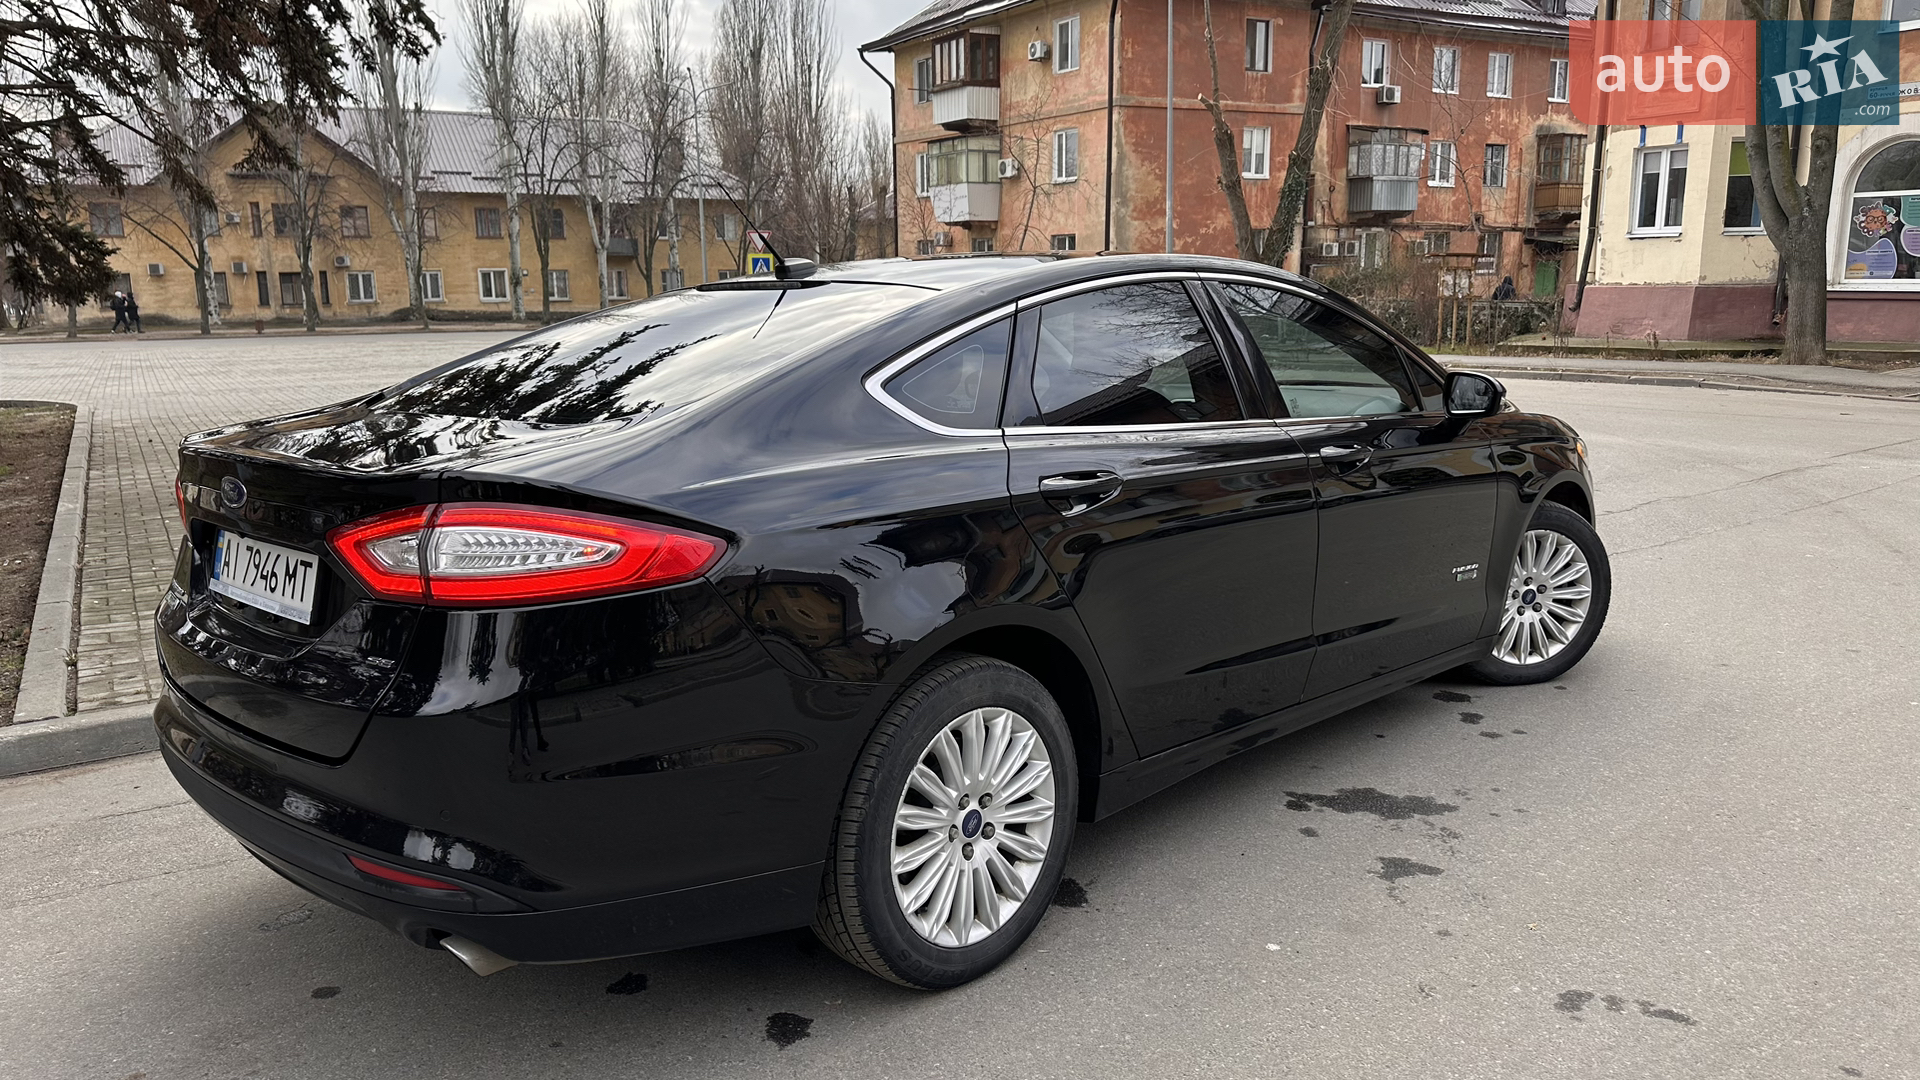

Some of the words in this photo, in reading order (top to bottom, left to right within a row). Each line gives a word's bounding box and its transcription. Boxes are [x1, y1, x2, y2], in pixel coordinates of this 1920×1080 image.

[221, 539, 240, 580] AI
[242, 545, 281, 592] 7946
[282, 556, 313, 602] MT
